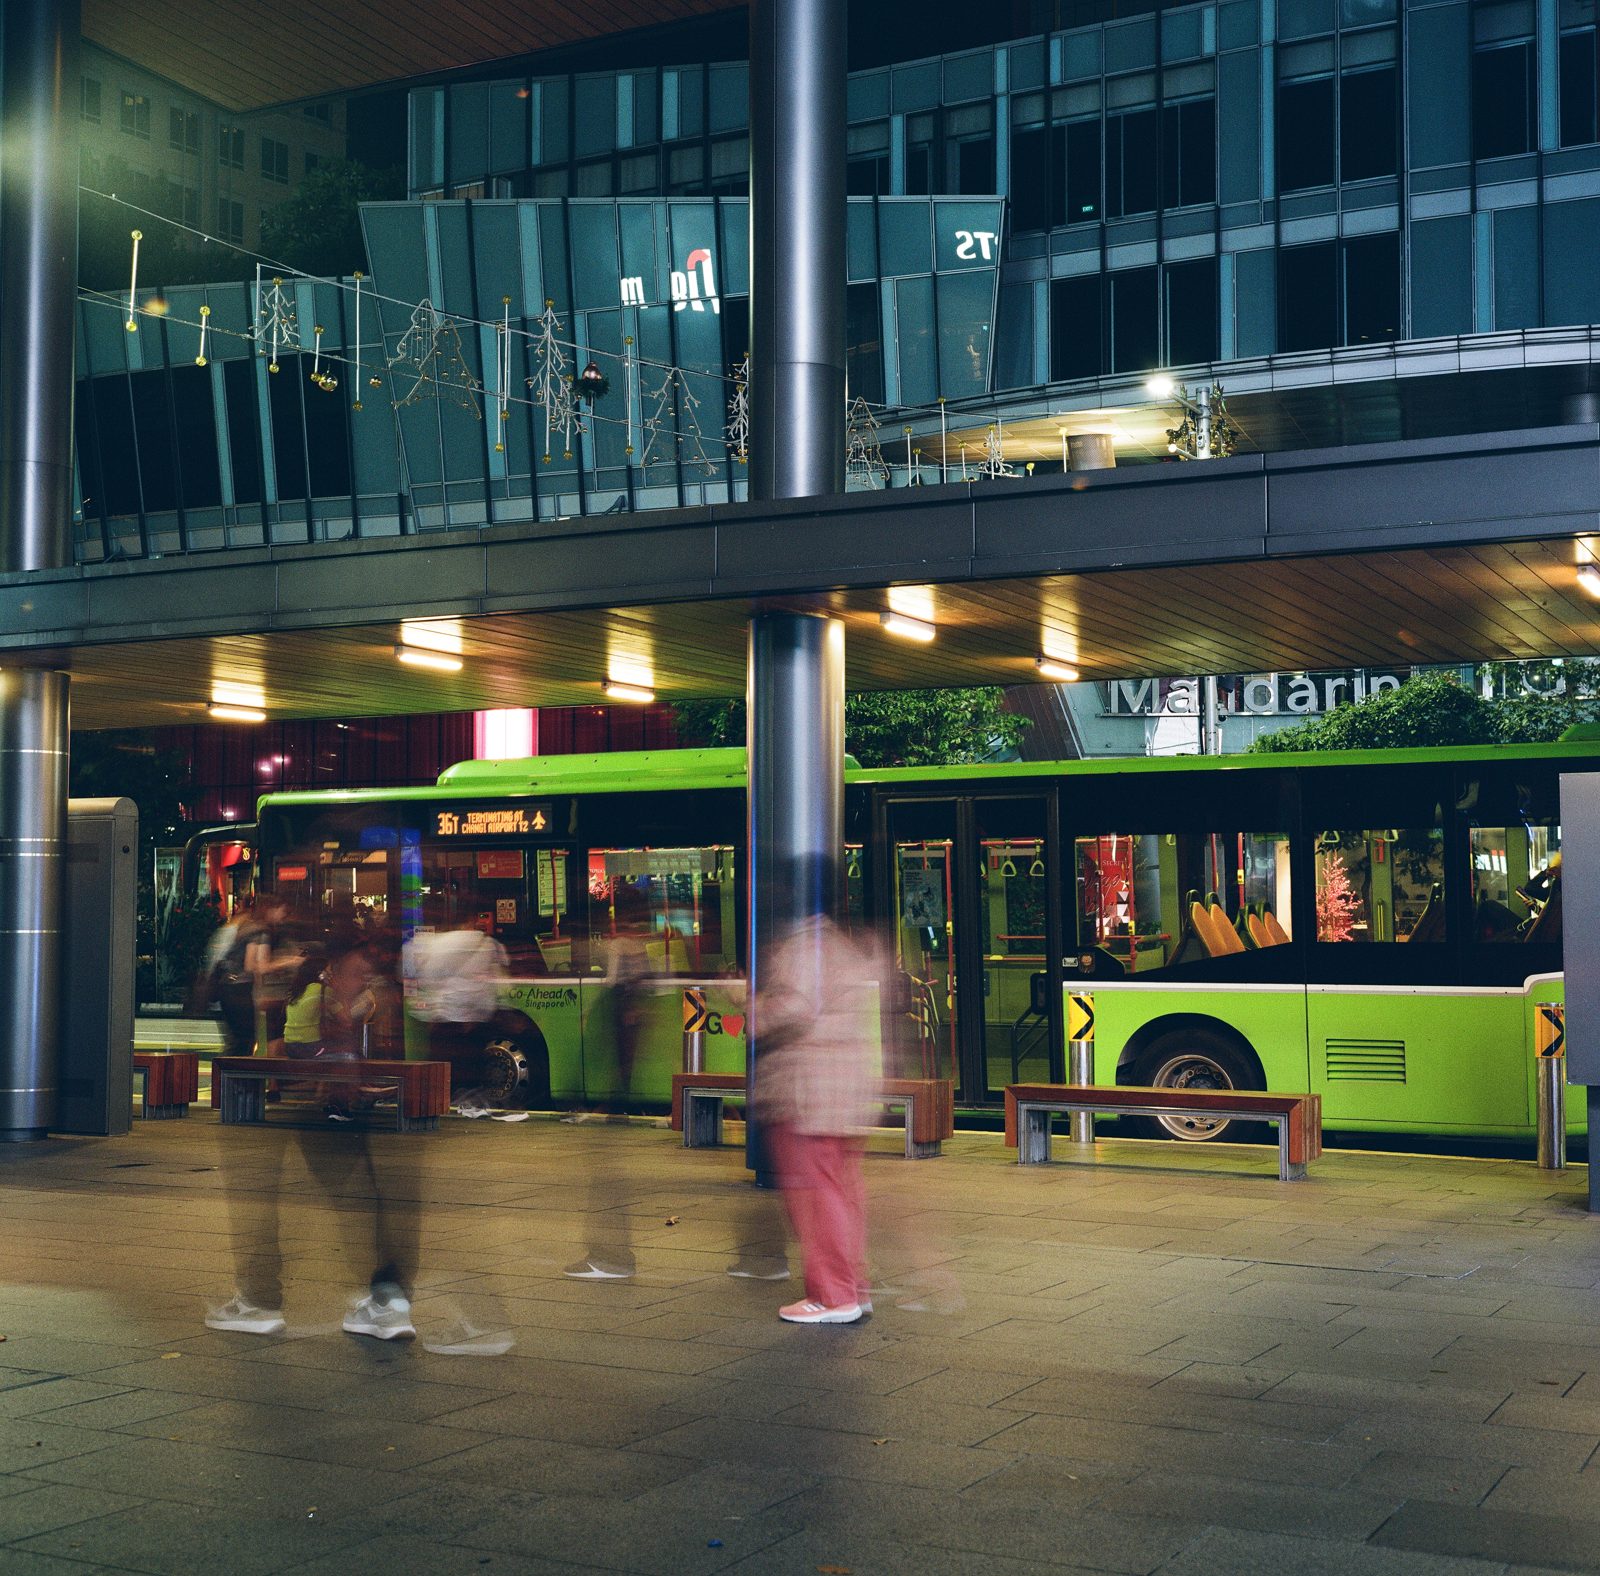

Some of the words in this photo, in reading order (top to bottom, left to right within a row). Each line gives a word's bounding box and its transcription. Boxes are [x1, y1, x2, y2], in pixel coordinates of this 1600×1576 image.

[466, 811, 513, 824] TERMINATING
[513, 810, 524, 822] AT
[461, 821, 487, 834] CHANGI
[487, 821, 517, 833] AIRPORT
[508, 988, 563, 1000] Go-Ahead
[525, 1000, 565, 1010] Singapore
